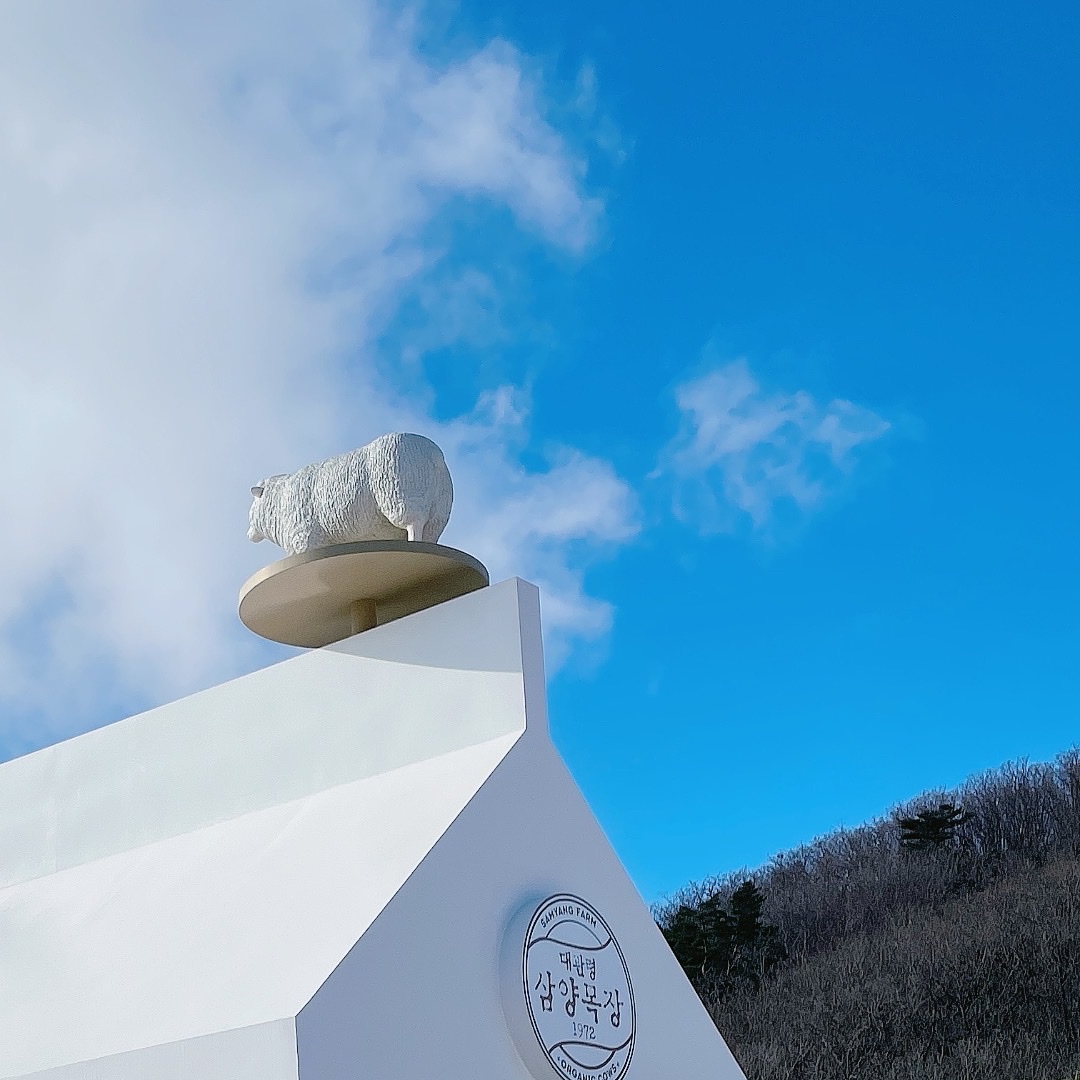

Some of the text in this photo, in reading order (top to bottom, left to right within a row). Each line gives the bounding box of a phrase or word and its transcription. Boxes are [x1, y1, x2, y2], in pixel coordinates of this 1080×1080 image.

[540, 905, 598, 928] SAMYANG FARM
[559, 951, 596, 981] 대관령
[535, 971, 624, 1027] 삼양목장
[572, 1021, 596, 1040] 1972
